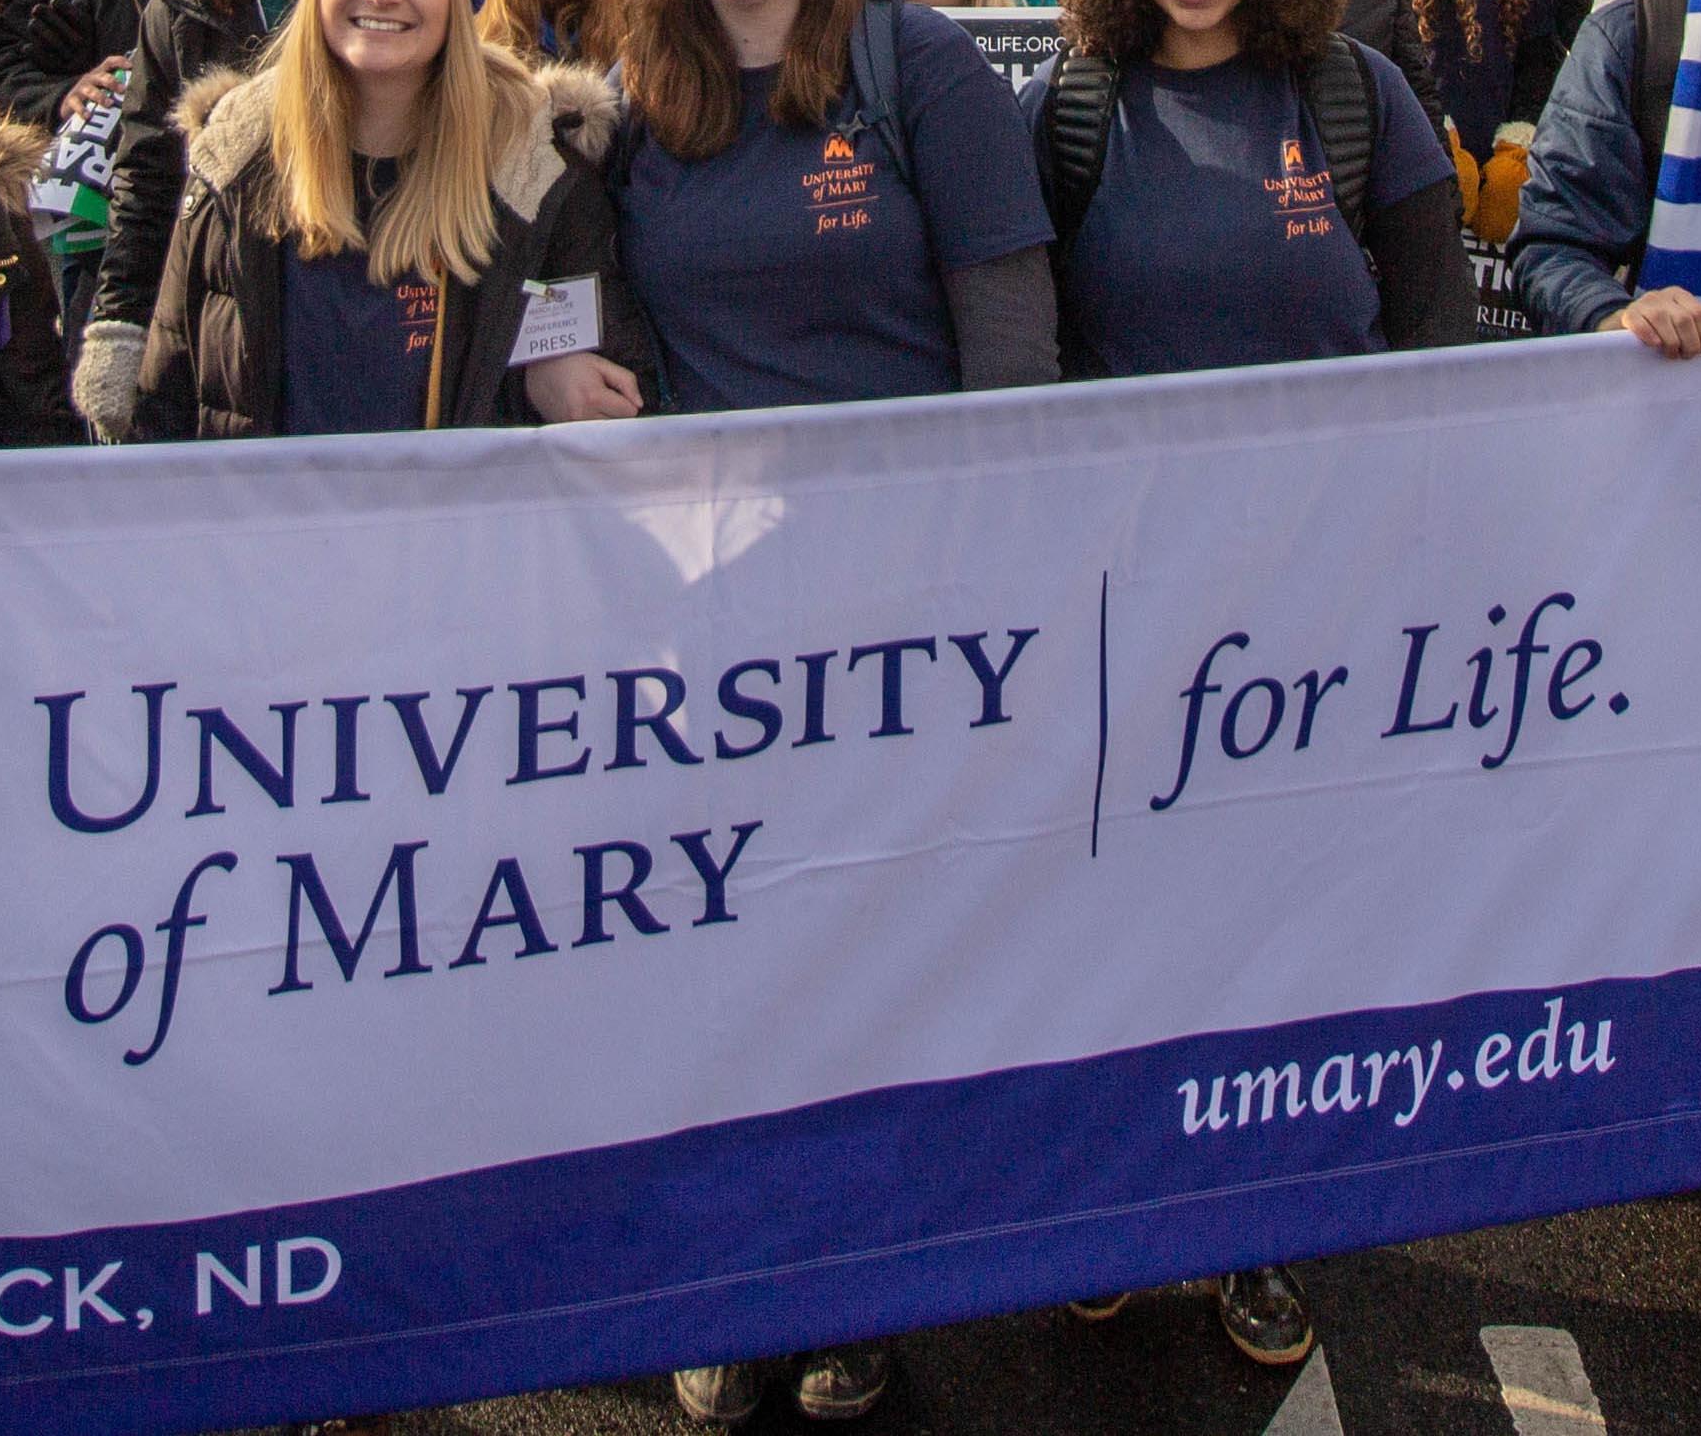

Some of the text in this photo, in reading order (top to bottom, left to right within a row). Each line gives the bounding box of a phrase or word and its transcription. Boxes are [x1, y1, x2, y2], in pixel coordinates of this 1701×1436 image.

[802, 163, 876, 188] UNIVERSITY
[813, 179, 867, 202] of MARY
[1278, 189, 1292, 209] of
[815, 208, 872, 235] for Life.
[1285, 219, 1307, 241] for
[524, 317, 579, 335] CONFERENCE
[405, 332, 429, 353] for
[529, 332, 577, 355] PRESS
[32, 591, 1633, 836] UNIVERSITY for Life.
[63, 819, 764, 1067] of MARY
[1176, 997, 1618, 1137] umary.edu
[194, 1234, 343, 1318] ND
